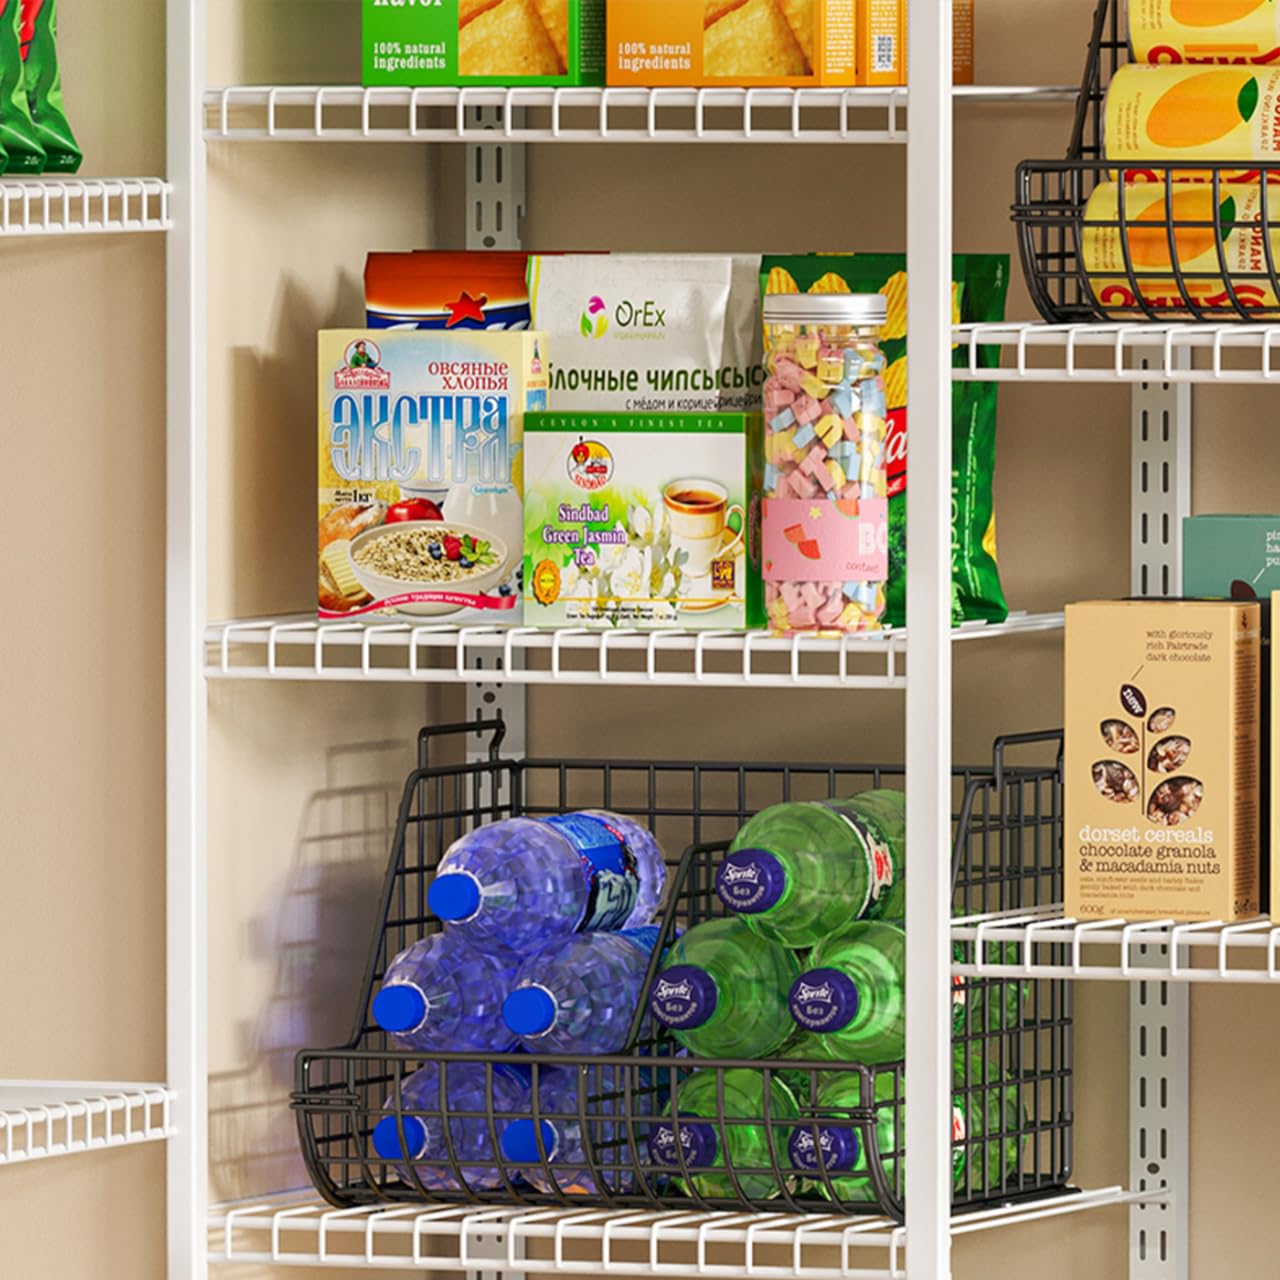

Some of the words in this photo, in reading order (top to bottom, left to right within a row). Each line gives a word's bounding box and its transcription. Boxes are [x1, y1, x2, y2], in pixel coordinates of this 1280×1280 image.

[373, 43, 401, 55] 100%
[404, 42, 446, 55] natural
[618, 42, 646, 55] 100%
[649, 42, 691, 55] natural
[373, 56, 446, 72] ingredients
[618, 56, 691, 71] ingredients
[615, 301, 666, 328] OrEx
[428, 361, 508, 376] ОВСЯНЫЕ
[442, 376, 508, 390] ХЛОПЬЯ
[629, 418, 685, 428] FINEST
[697, 418, 725, 428] TEA
[331, 393, 510, 482] ЭКСТРА
[558, 503, 609, 522] Sindbad
[542, 525, 579, 543] Green
[582, 525, 627, 545] Jasmin
[574, 547, 595, 566] Tea
[1145, 629, 1165, 639] with
[1167, 629, 1214, 641] gloriously
[1145, 641, 1164, 651] rich
[1165, 641, 1209, 651] Fairtrade
[1145, 652, 1167, 662] dark
[1168, 652, 1212, 662] chocolate
[1079, 825, 1141, 843] dorset
[1144, 826, 1213, 844] cereals
[1079, 843, 1153, 858] chocolate
[1155, 844, 1217, 861] granola
[1079, 858, 1093, 873] &
[1095, 860, 1183, 875] macadamia
[1186, 862, 1221, 875] nuts
[1079, 903, 1105, 916] 600g
